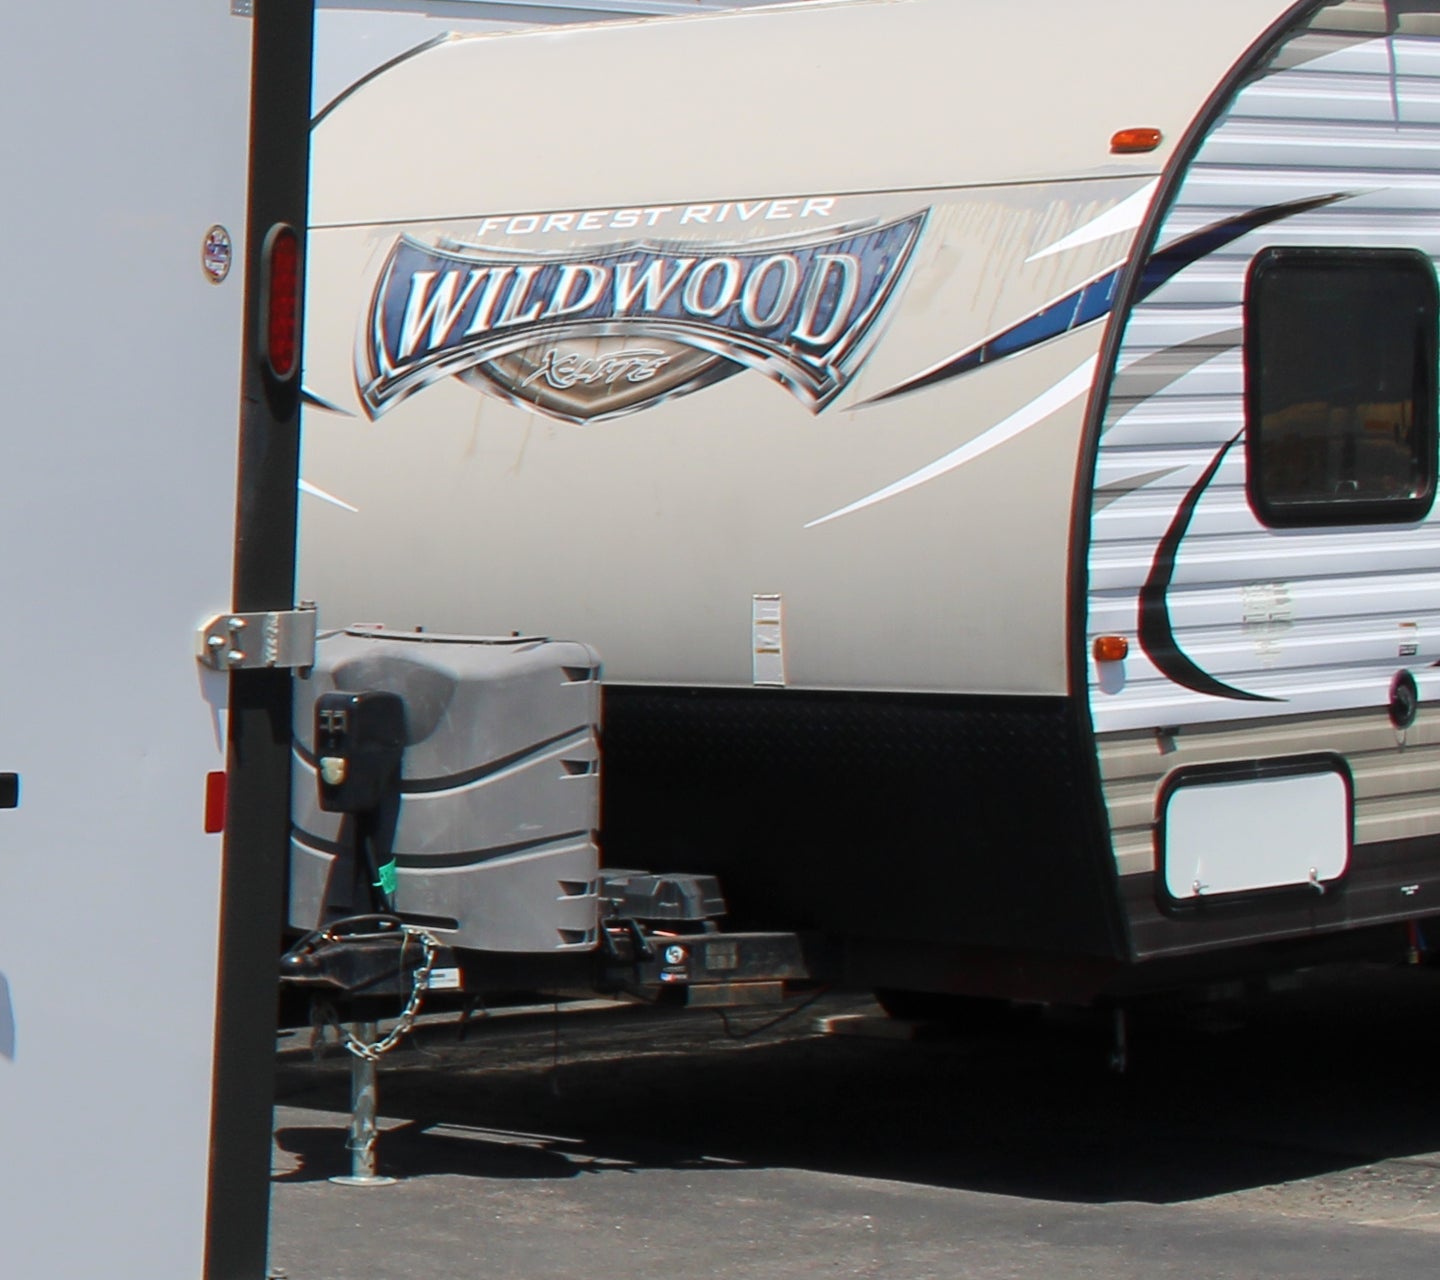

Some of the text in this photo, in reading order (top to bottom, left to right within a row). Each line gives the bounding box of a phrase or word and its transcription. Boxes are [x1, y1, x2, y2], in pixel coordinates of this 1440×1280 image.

[477, 196, 837, 237] FOREST RIVER
[396, 253, 863, 361] WILDWOOD
